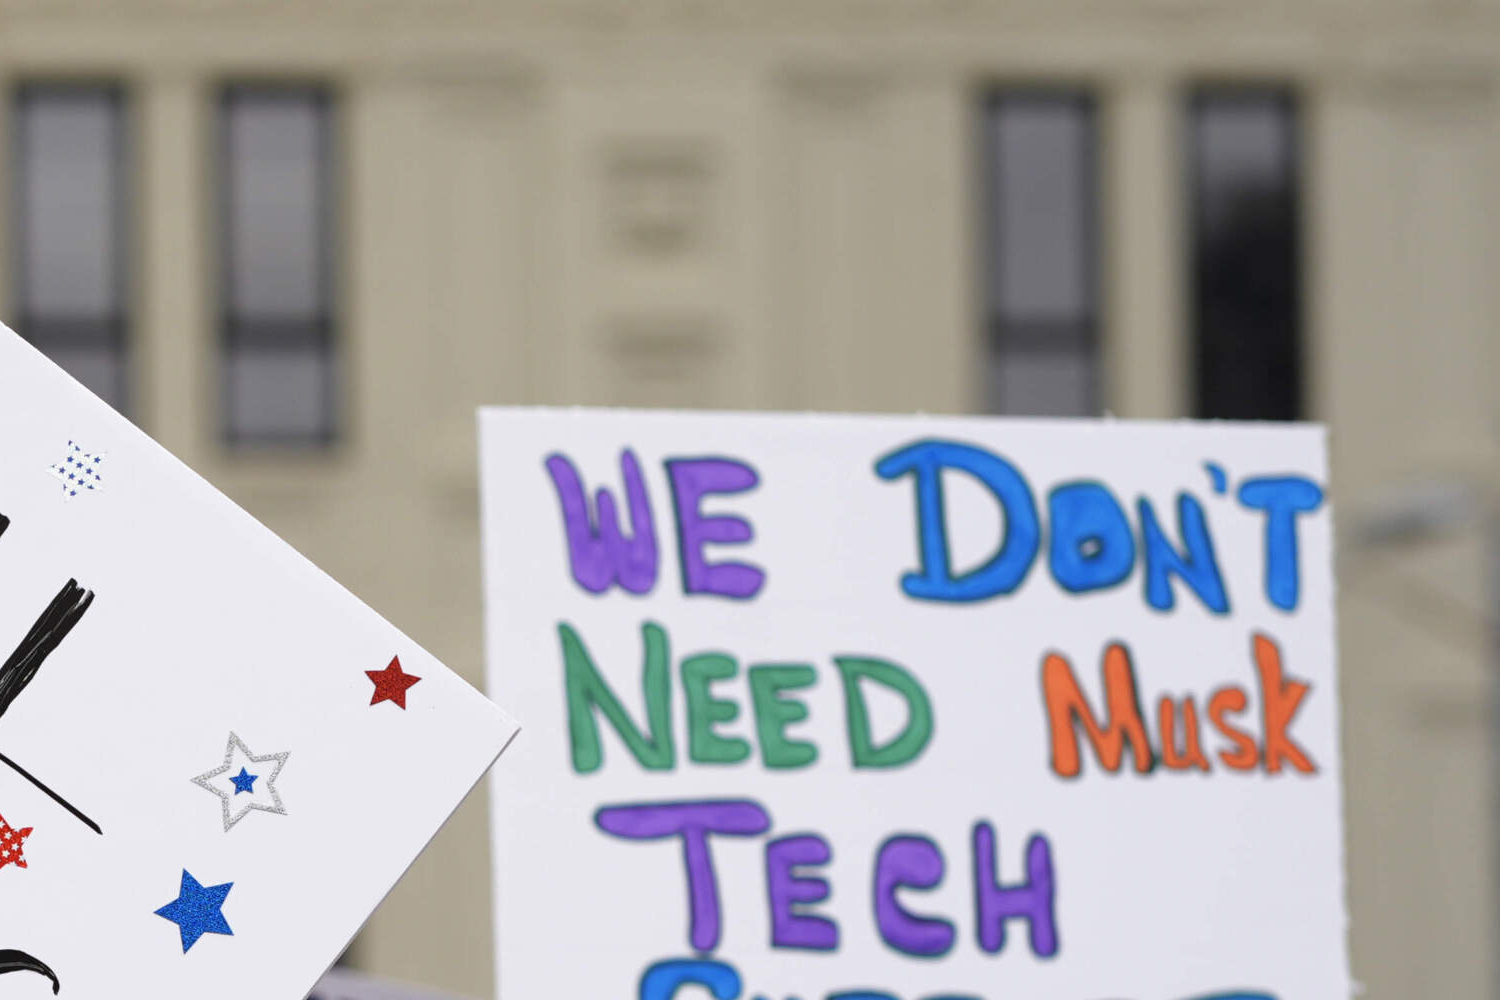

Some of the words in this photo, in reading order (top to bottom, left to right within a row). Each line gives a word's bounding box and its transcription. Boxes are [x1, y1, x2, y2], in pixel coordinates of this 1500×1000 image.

[546, 449, 766, 601] WE
[874, 438, 1324, 616] DON'T
[558, 622, 933, 774] NEED
[1041, 634, 1317, 779] Musk
[593, 800, 1061, 959] TECH
